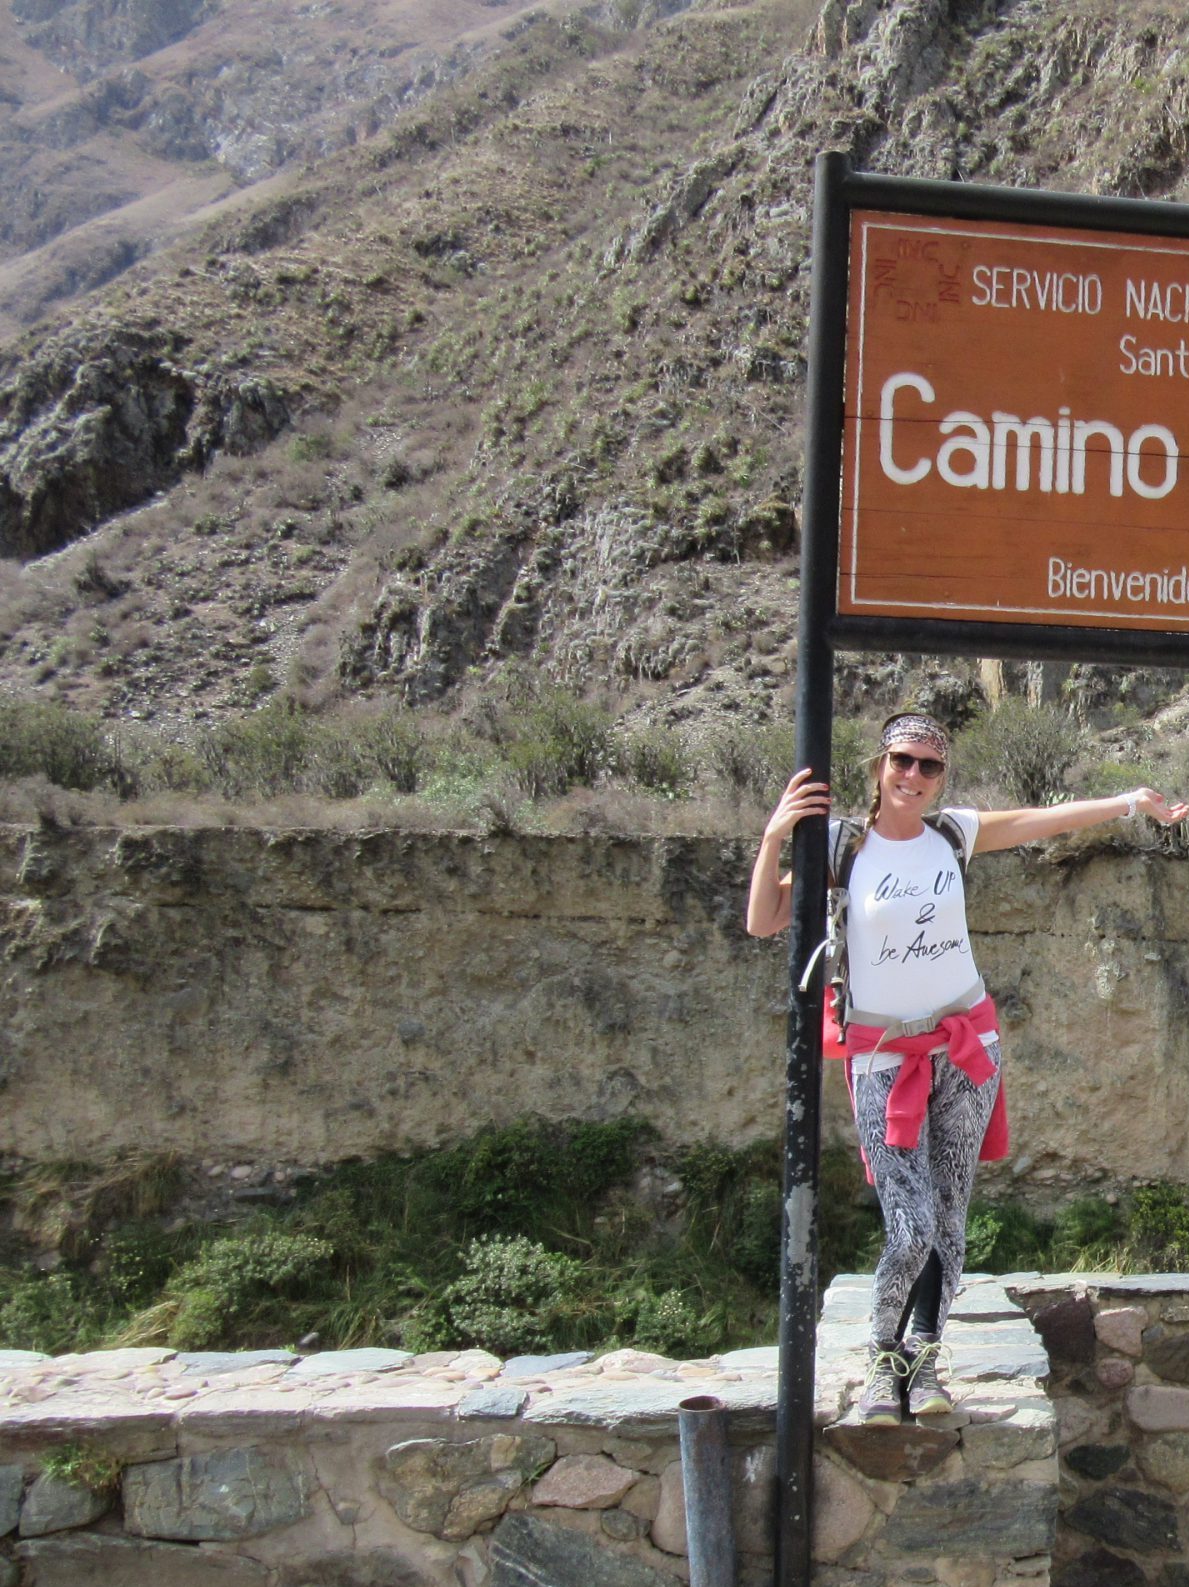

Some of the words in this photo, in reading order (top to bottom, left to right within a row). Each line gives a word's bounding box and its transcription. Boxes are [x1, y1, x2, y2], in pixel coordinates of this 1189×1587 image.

[971, 264, 1102, 315] SERVICIO
[879, 371, 1179, 500] Camino
[874, 873, 930, 901] Wake
[915, 902, 936, 925] &
[871, 934, 900, 966] be
